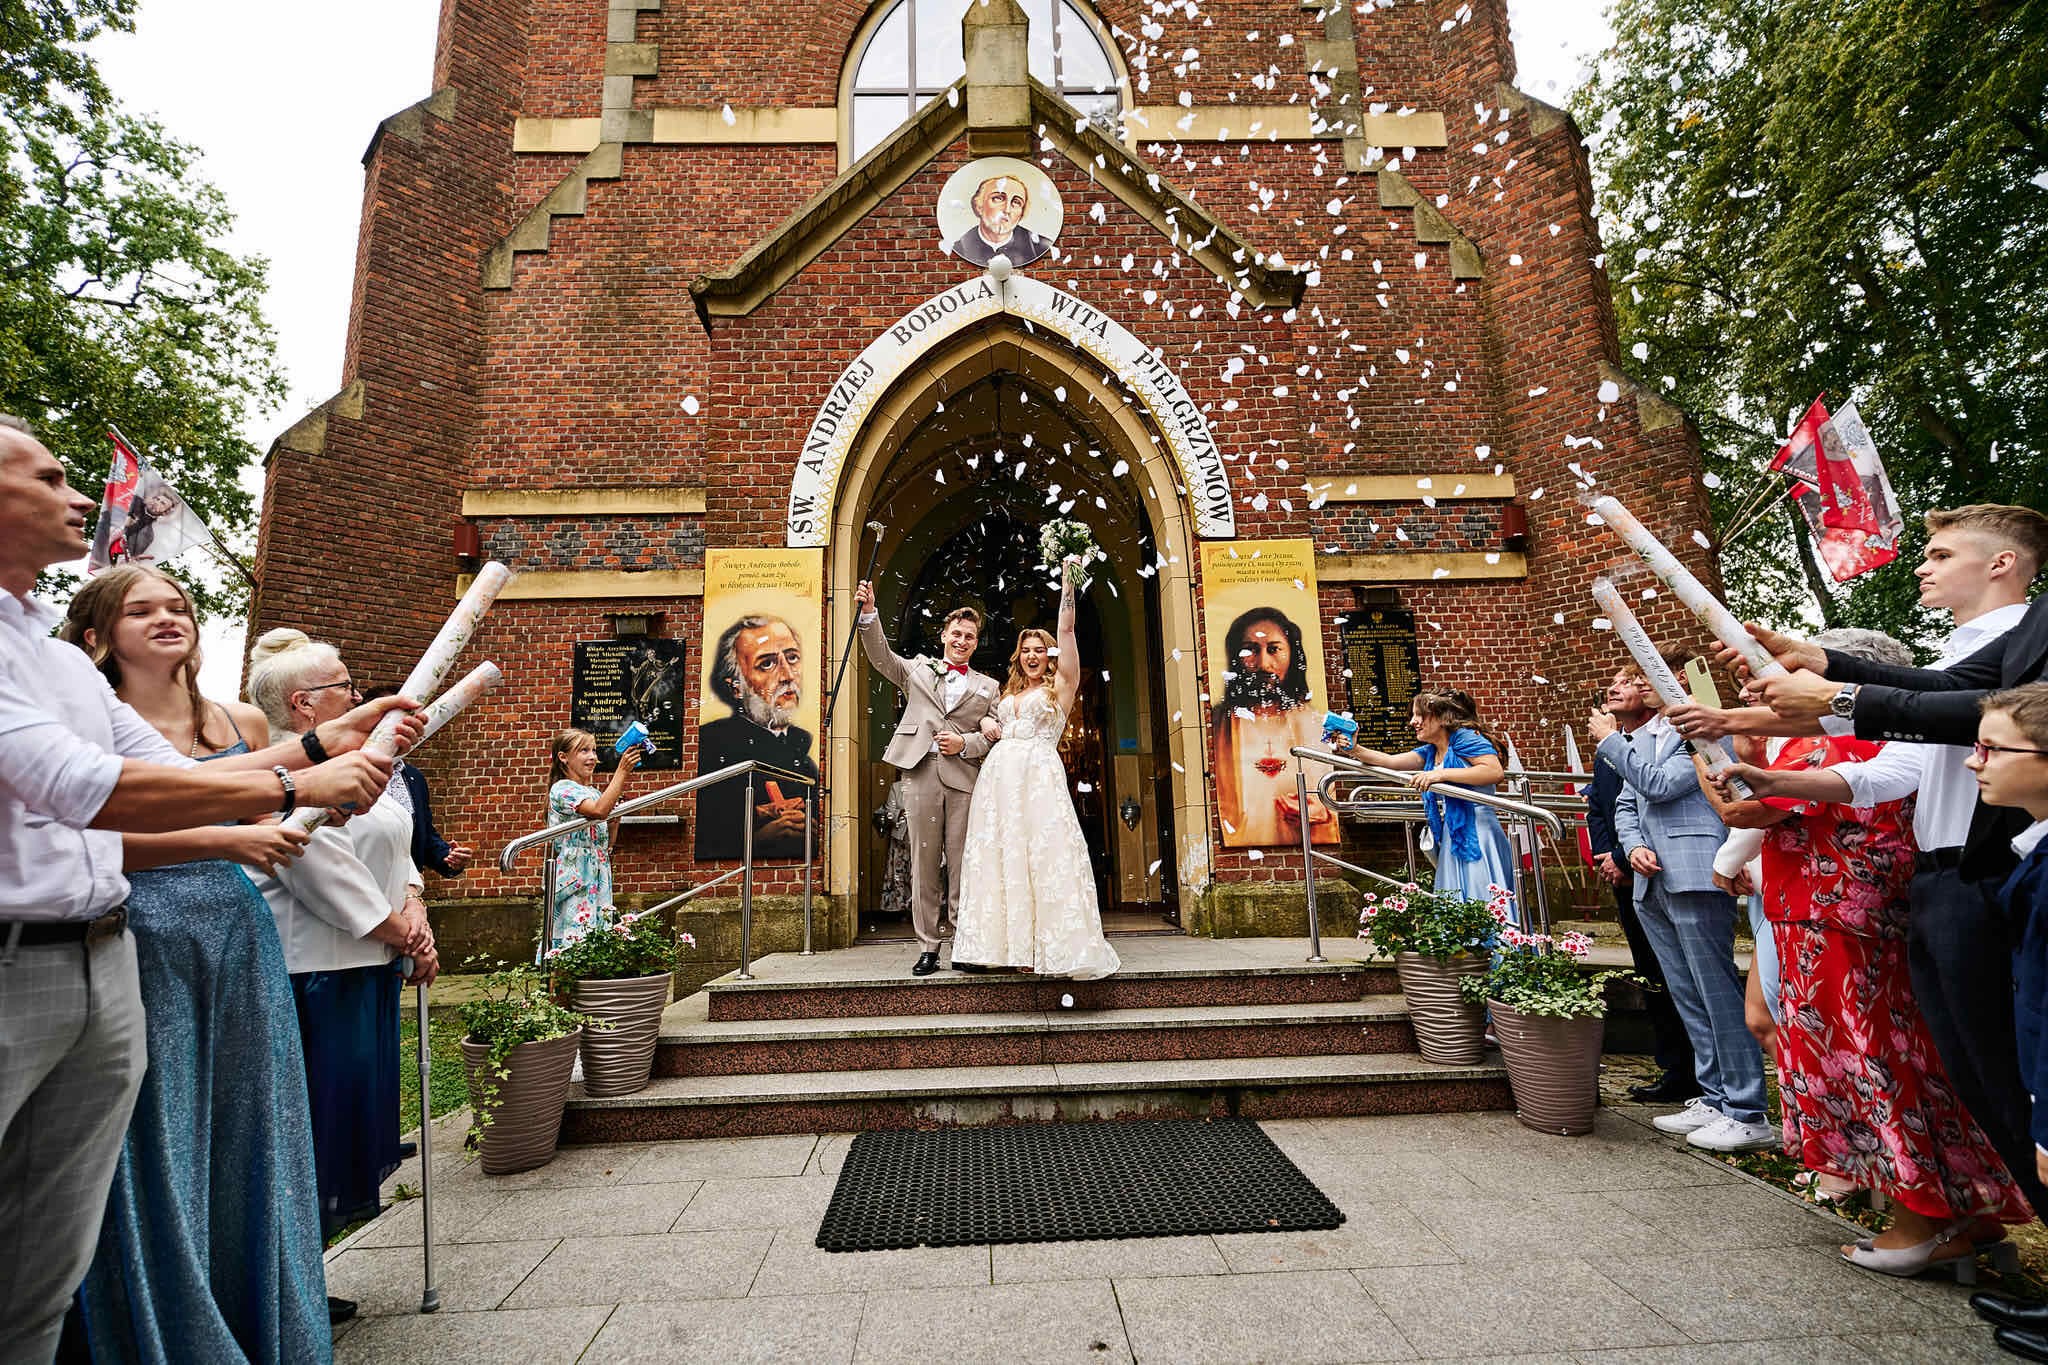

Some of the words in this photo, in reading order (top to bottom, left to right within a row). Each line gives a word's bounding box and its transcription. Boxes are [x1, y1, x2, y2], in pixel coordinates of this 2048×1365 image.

[788, 495, 815, 534] ŚW.
[803, 358, 874, 475] ANDRZEJ
[890, 279, 995, 346] BOBOLA
[1050, 292, 1109, 339] WITA
[1132, 350, 1231, 523] PIELGRZYMÓW
[593, 698, 627, 706] Andrzeja
